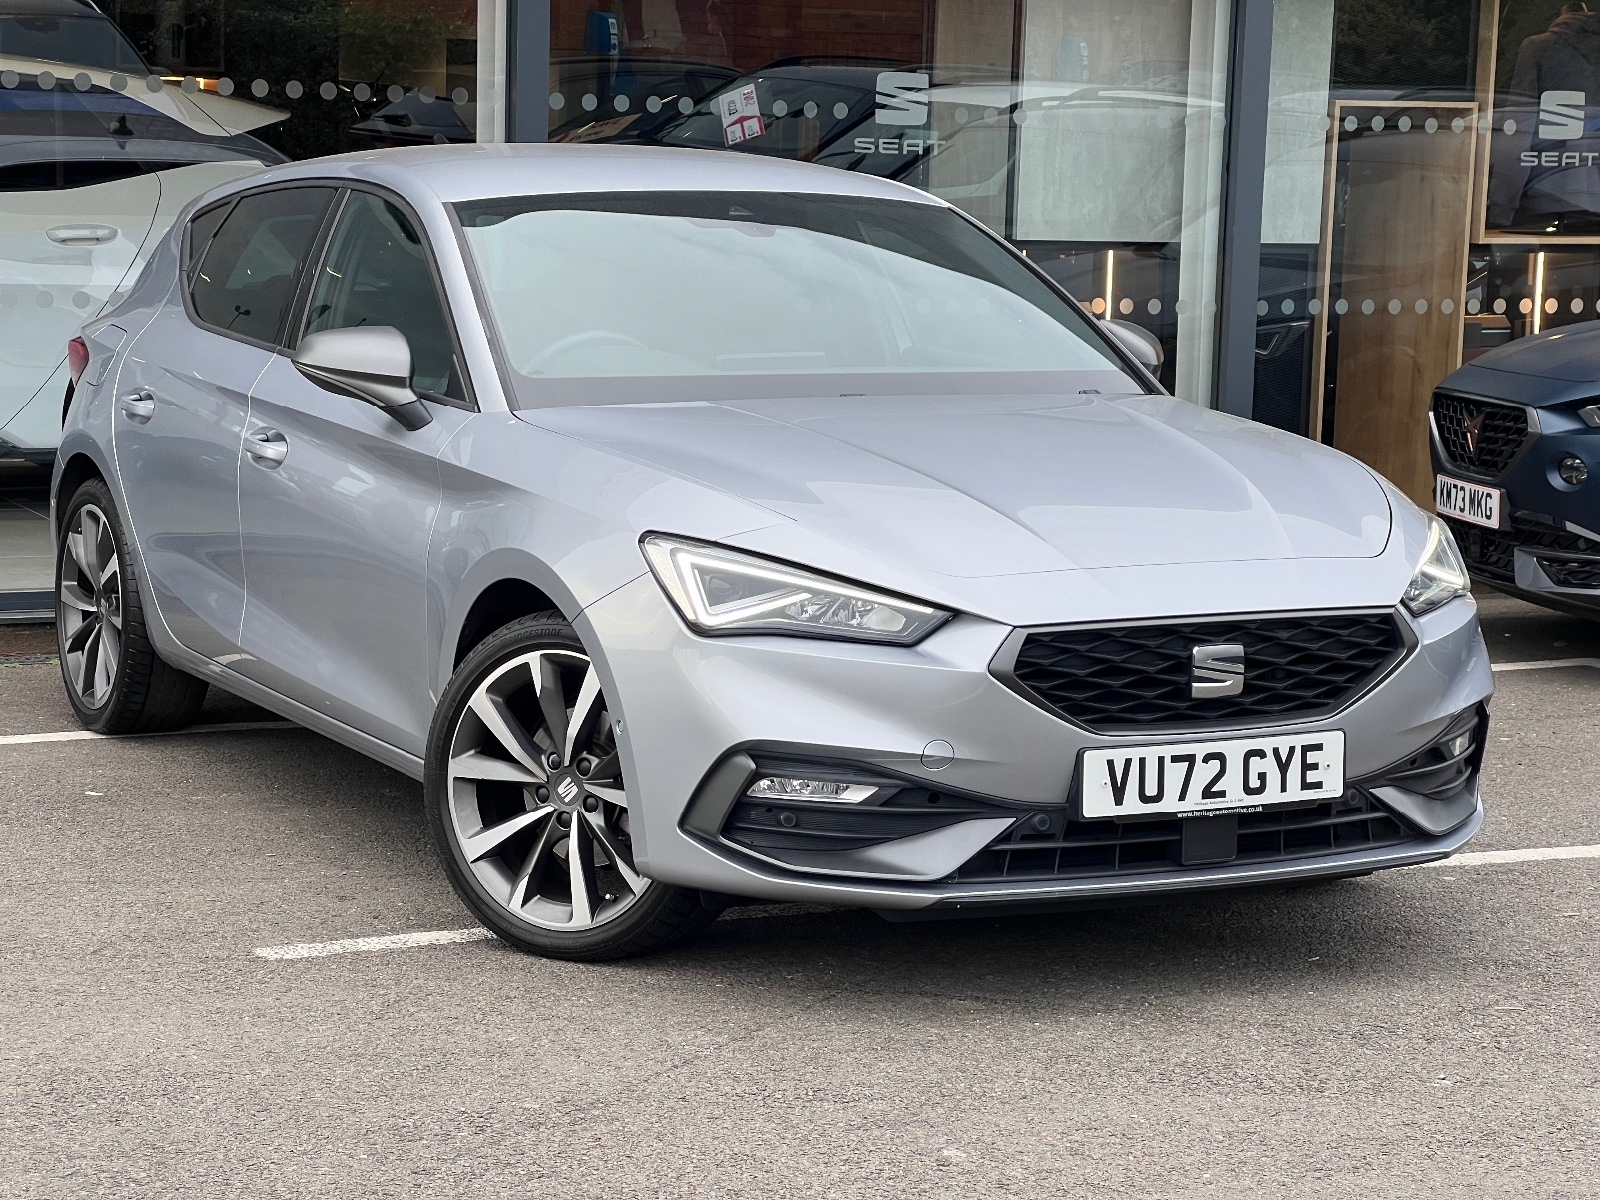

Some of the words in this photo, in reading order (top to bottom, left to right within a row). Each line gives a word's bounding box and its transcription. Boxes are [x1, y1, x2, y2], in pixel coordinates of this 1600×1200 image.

[854, 137, 946, 155] SEAT
[1520, 151, 1599, 167] SEAT
[1440, 479, 1466, 513] KM73
[1468, 488, 1493, 520] MKG
[502, 628, 563, 643] BRIDGESTONE
[1106, 752, 1228, 806] VU72
[1242, 742, 1325, 796] GYE
